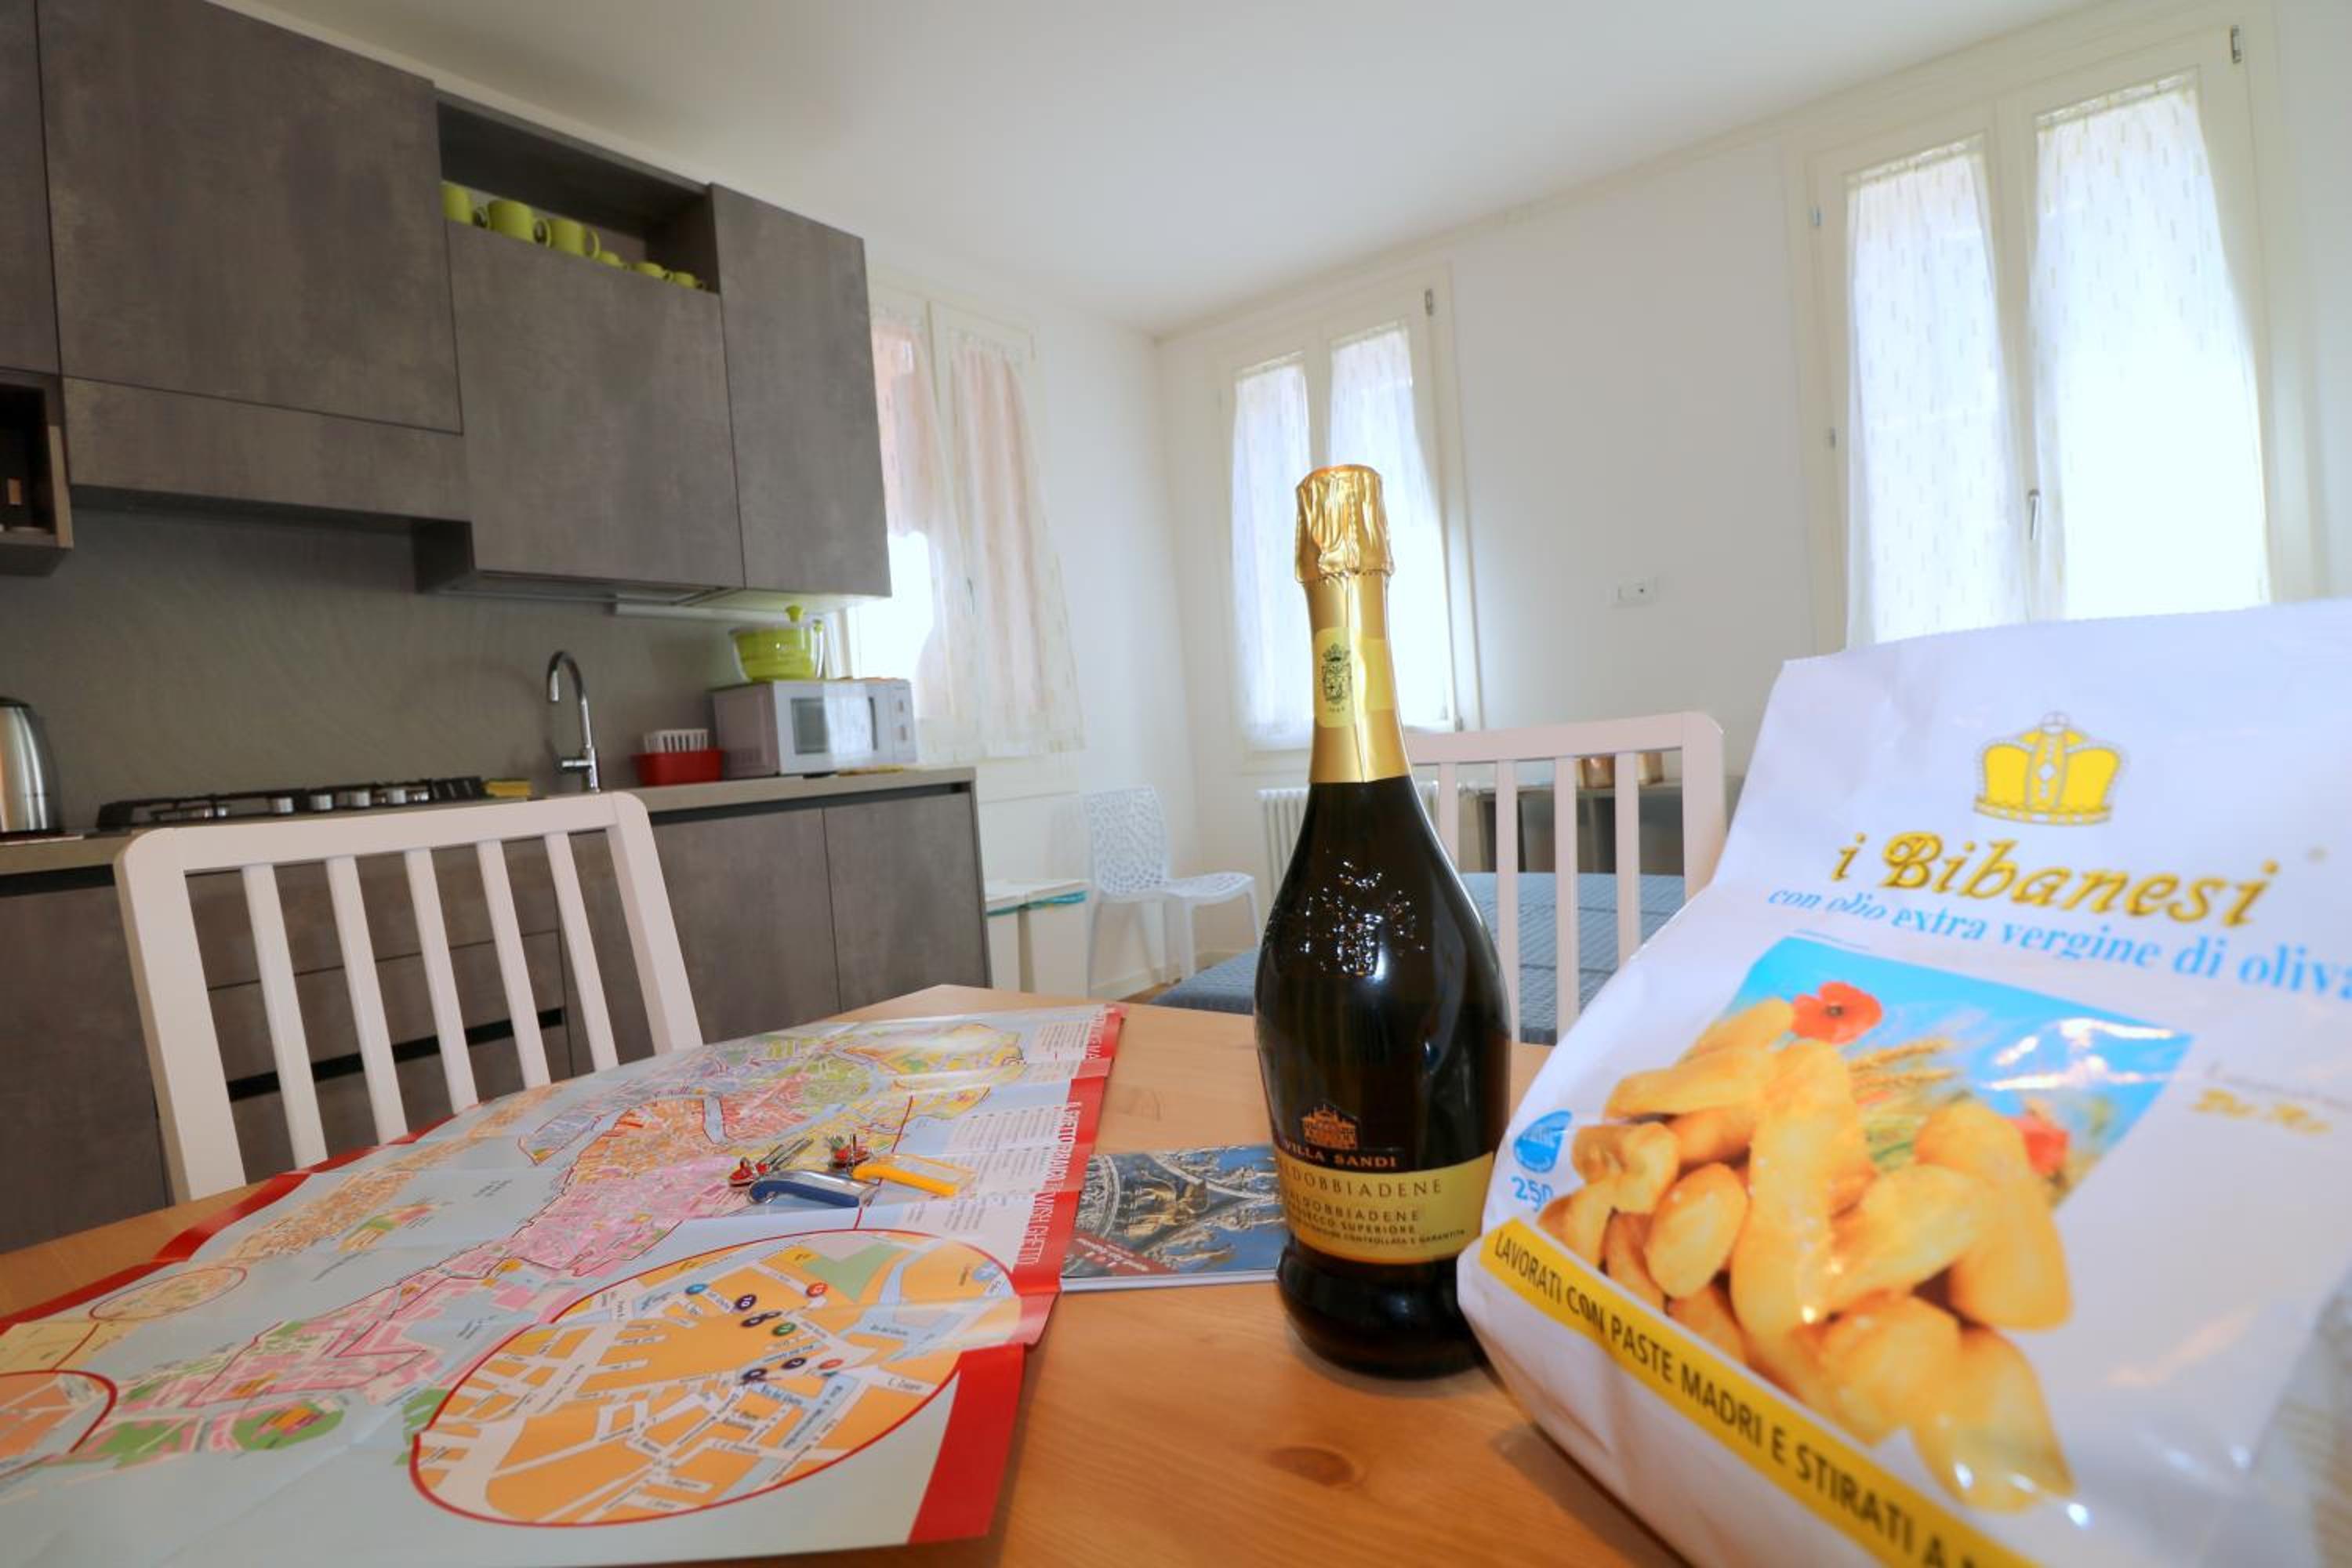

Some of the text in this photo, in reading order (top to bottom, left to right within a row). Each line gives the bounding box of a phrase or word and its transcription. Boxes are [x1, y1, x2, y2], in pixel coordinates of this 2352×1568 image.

[1831, 831, 2280, 928] i Bibanesi
[1768, 888, 1822, 912] con
[1826, 893, 1888, 921] olio
[1892, 907, 1987, 941] extra
[2001, 921, 2161, 968] vergine
[2172, 935, 2228, 978] di
[1057, 1110, 1080, 1143] GHETTO
[1284, 1140, 1396, 1167] VILLA SANDI
[1017, 1225, 1049, 1265] GHETTO
[1341, 1221, 1415, 1235] SUPERIORE
[1494, 1231, 1947, 1568] LAVORATI CON PASTE MADRI E STIRATI A
